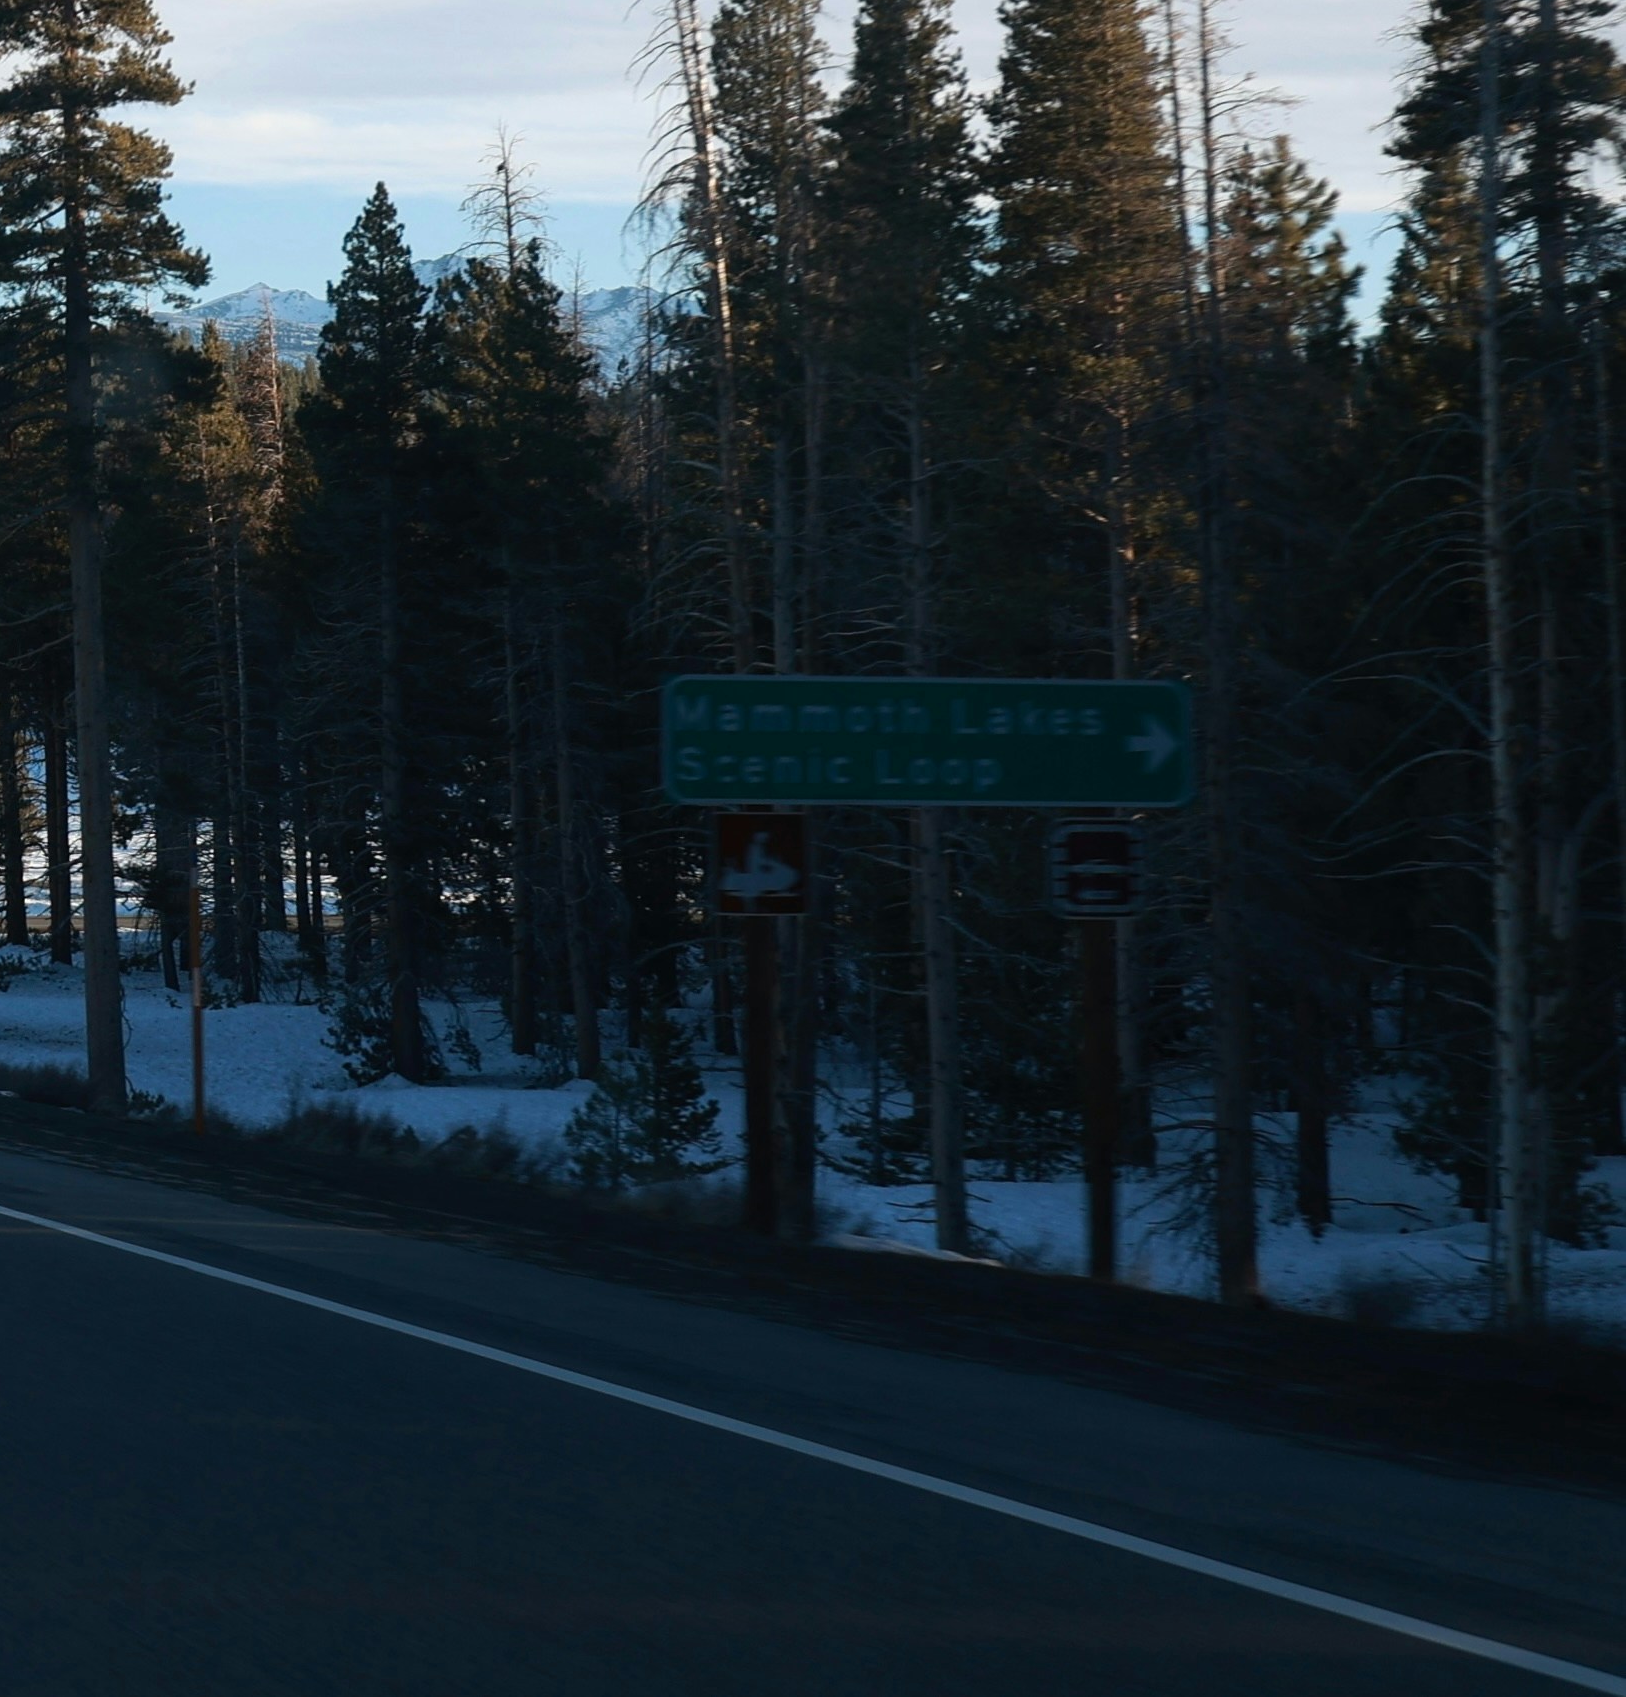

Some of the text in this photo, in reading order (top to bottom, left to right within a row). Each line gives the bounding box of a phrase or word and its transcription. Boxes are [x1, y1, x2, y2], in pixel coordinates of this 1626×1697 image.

[672, 694, 1103, 736] Mammoth Lakes
[675, 746, 1003, 793] Scenic Loop
